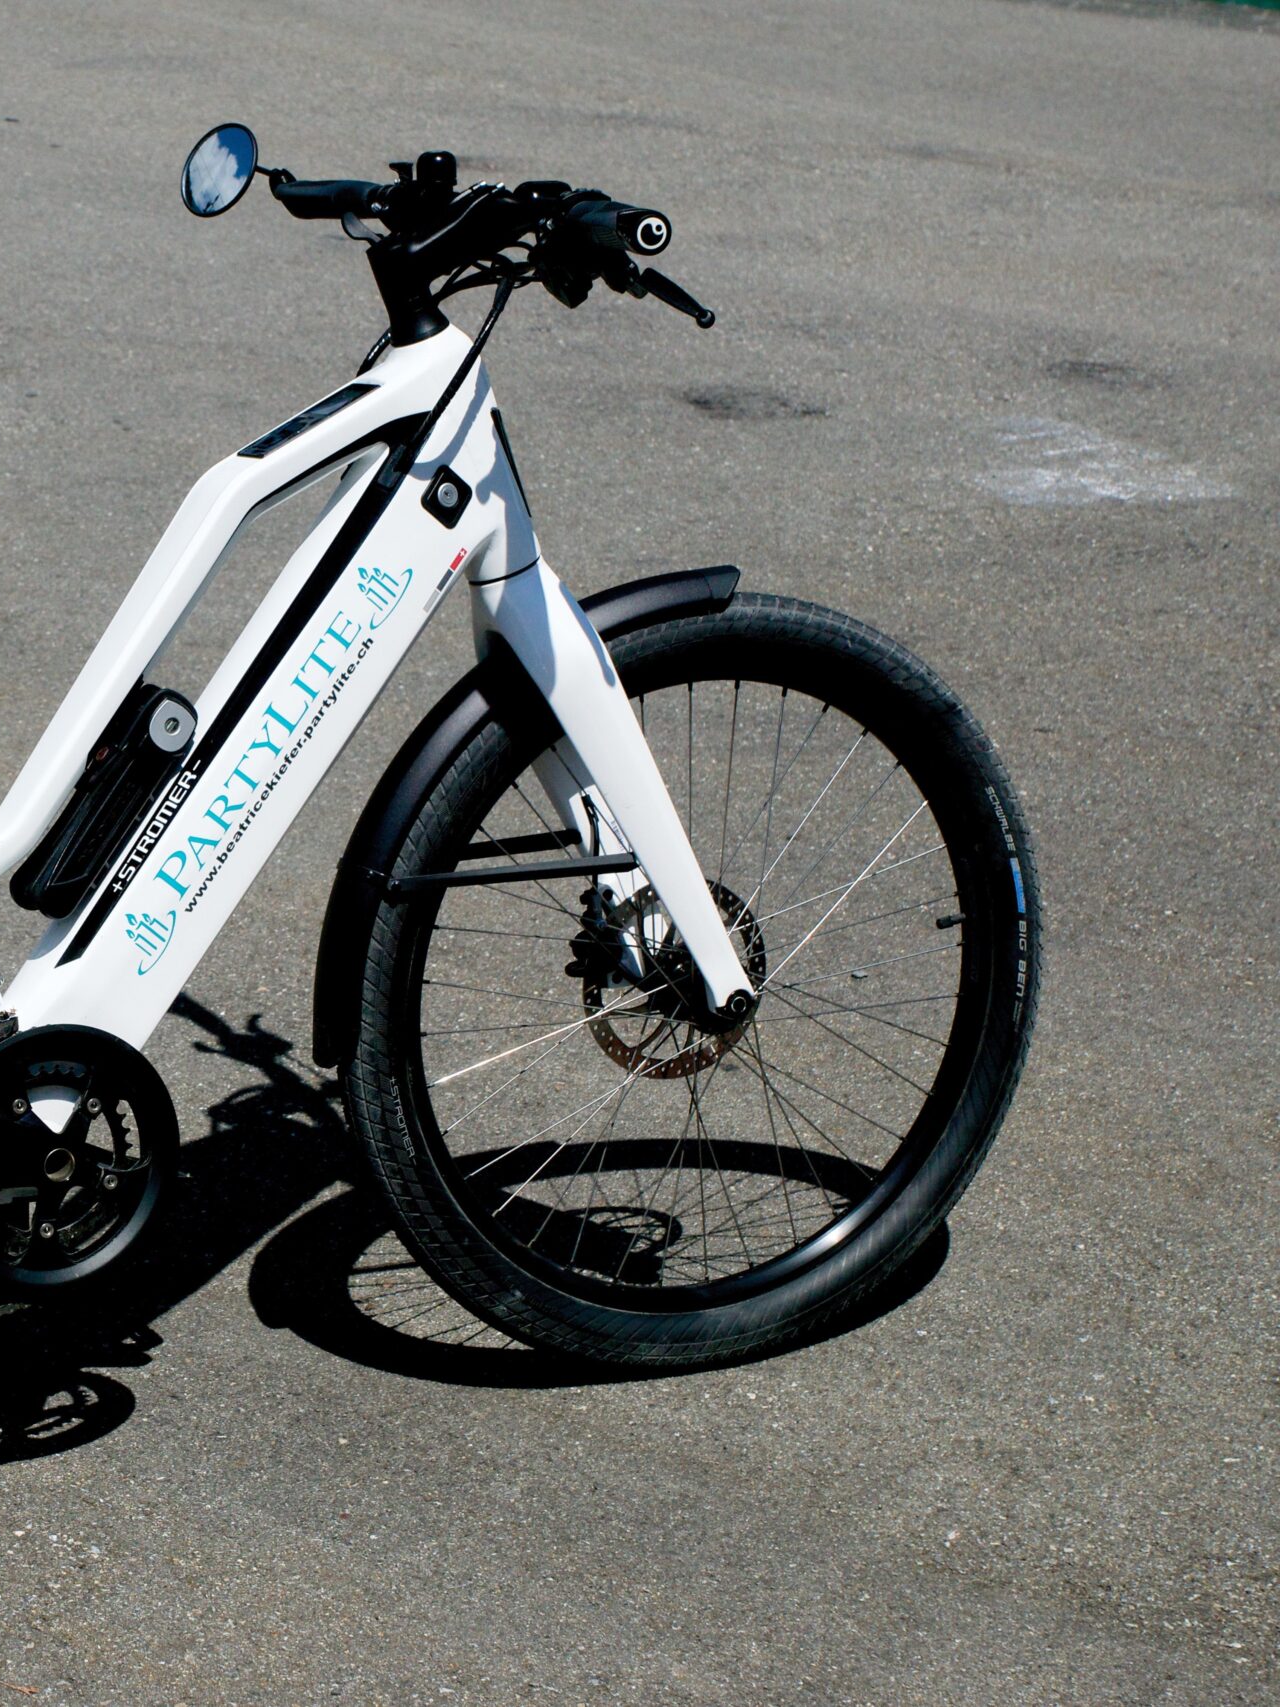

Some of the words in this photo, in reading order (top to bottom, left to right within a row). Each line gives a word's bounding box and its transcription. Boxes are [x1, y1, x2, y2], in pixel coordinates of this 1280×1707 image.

[153, 610, 362, 901] PARTYLITE
[184, 637, 375, 914] www.beatricekiefer.partylite.ch
[983, 785, 1018, 853] SCHWALBE
[1017, 920, 1029, 952] BIG
[1015, 959, 1028, 997] BEN
